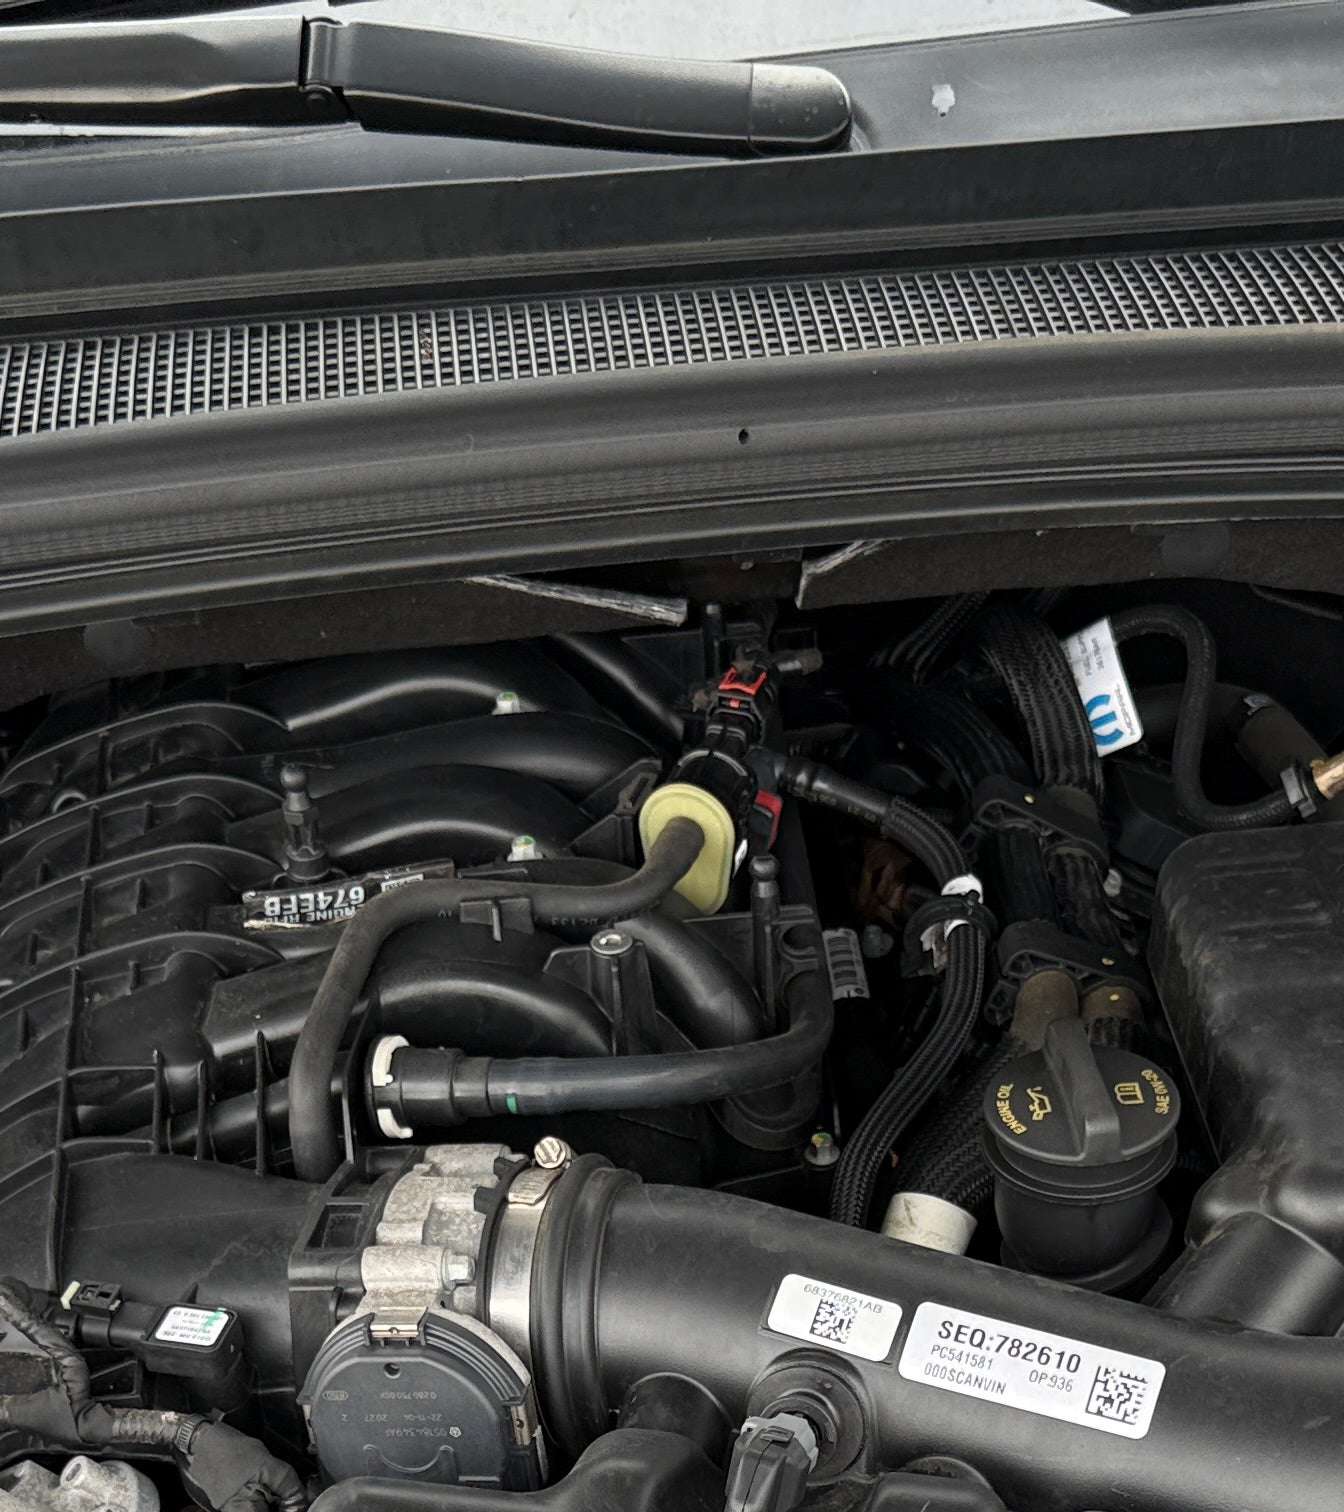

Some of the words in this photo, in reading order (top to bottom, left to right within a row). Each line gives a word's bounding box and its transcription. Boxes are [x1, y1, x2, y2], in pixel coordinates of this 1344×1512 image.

[264, 886, 365, 917] 674EFB
[996, 1083, 1014, 1100] OIL
[1154, 1095, 1171, 1115] SAE
[996, 1100, 1028, 1135] ENGINE
[803, 1283, 884, 1315] 68376821AB
[930, 1344, 994, 1372] PC541581
[937, 1320, 1083, 1374] SEQ:782610
